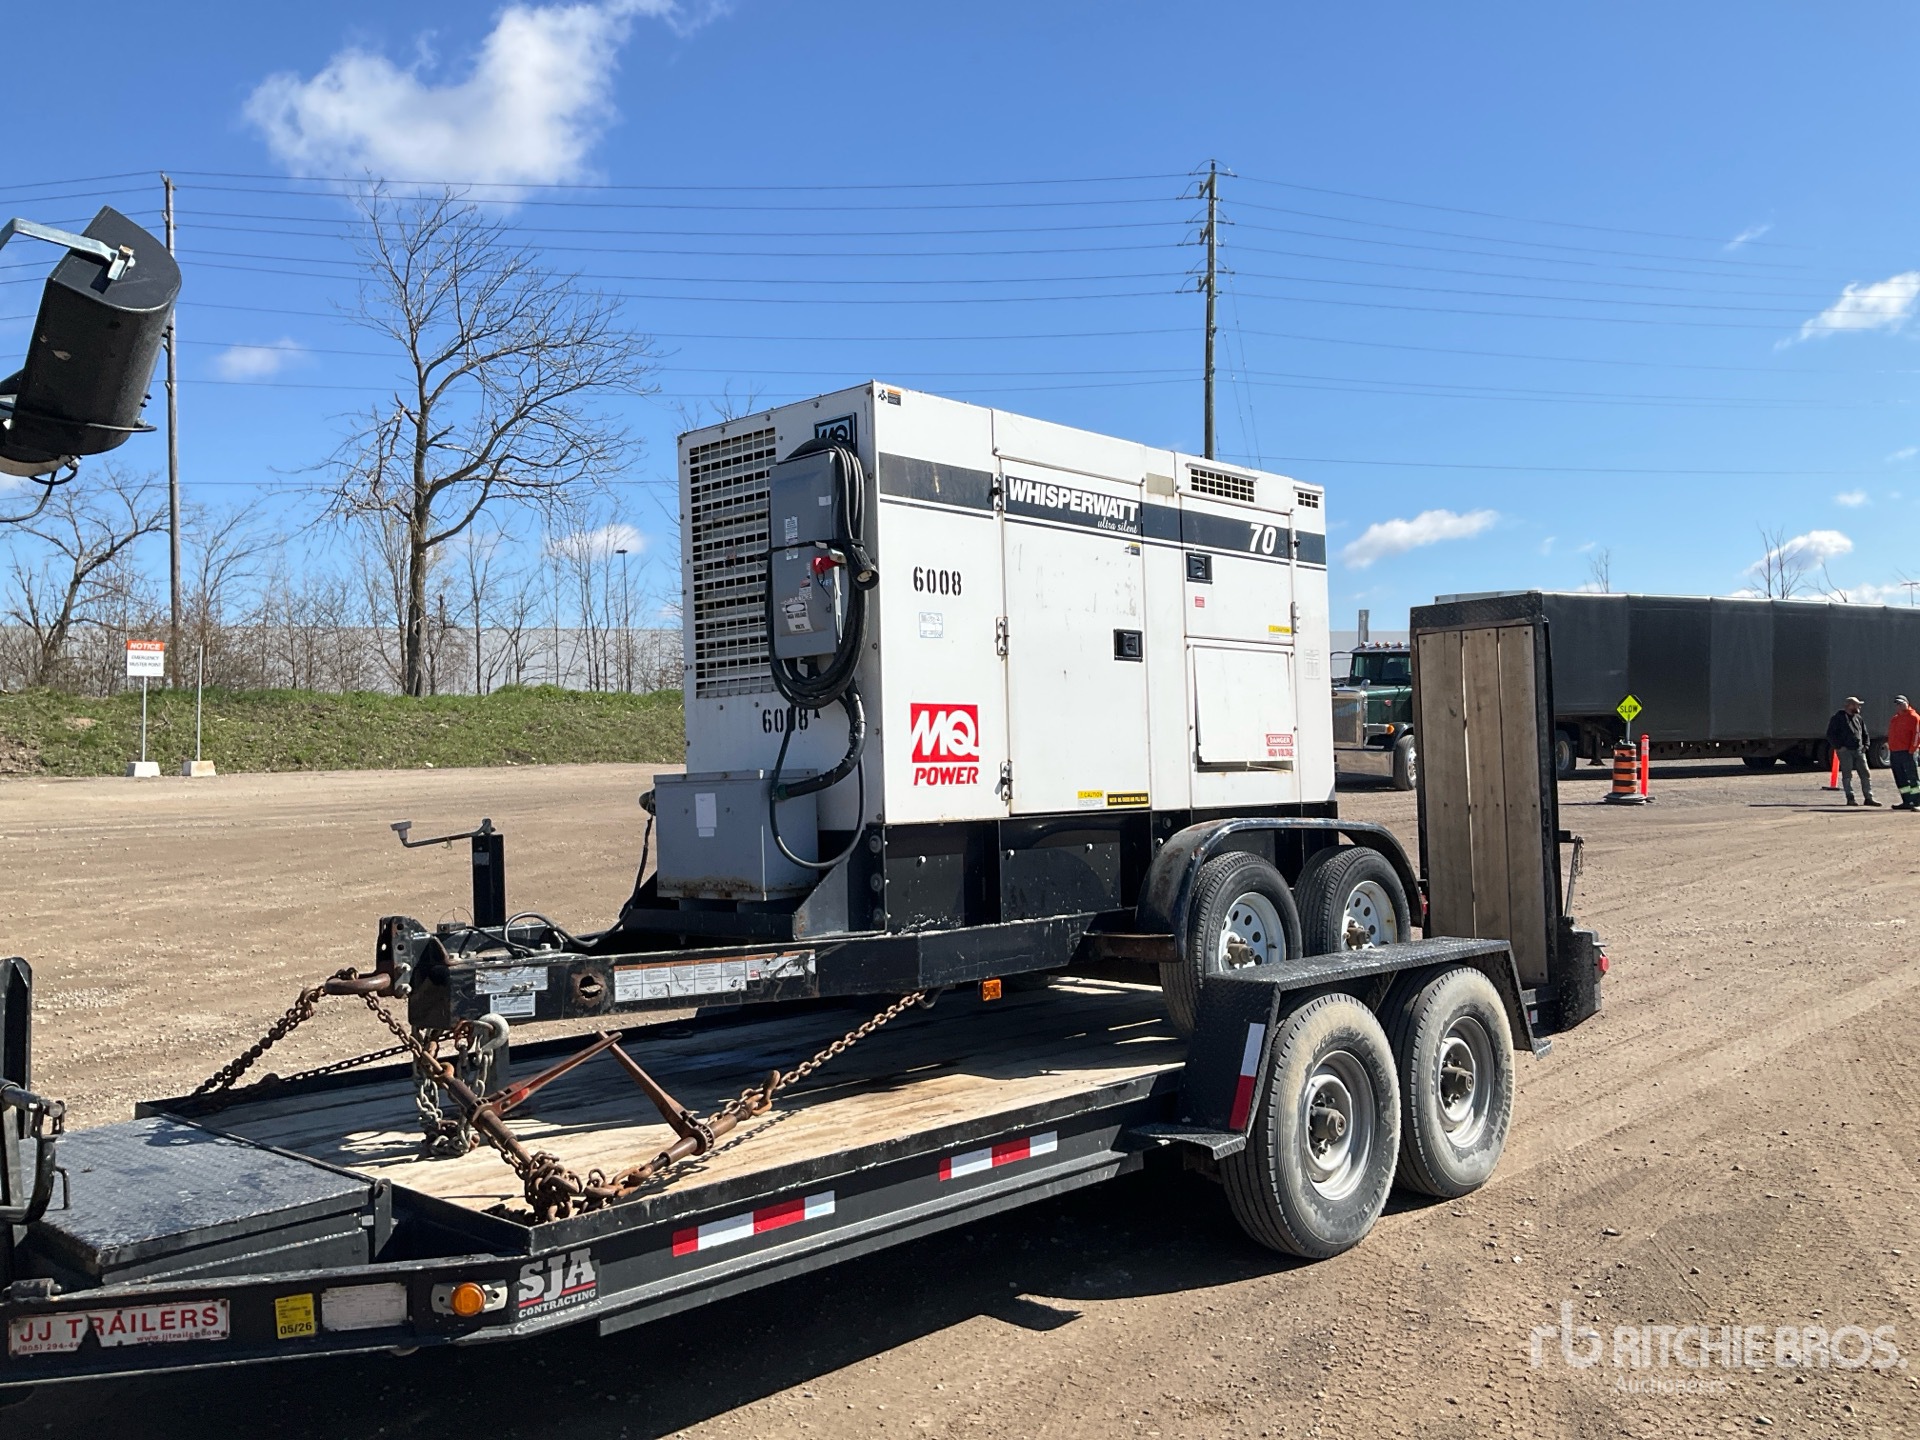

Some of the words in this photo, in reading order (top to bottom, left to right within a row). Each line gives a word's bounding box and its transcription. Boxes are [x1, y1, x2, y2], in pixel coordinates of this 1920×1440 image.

[1008, 477, 1139, 522] WHISPERWATT
[1097, 516, 1117, 531] ultra
[1117, 519, 1138, 534] silent
[1249, 523, 1277, 555] 70
[913, 565, 963, 597] 6008
[1620, 705, 1638, 713] SLOW
[911, 709, 979, 757] MQ
[1269, 736, 1291, 745] DANGER
[913, 765, 979, 786] POWER
[518, 1247, 597, 1302] SJA
[518, 1288, 597, 1319] CONTRACTING
[20, 1321, 51, 1342] JJ
[66, 1307, 219, 1339] TRAILERS
[280, 1321, 312, 1335] 05/26
